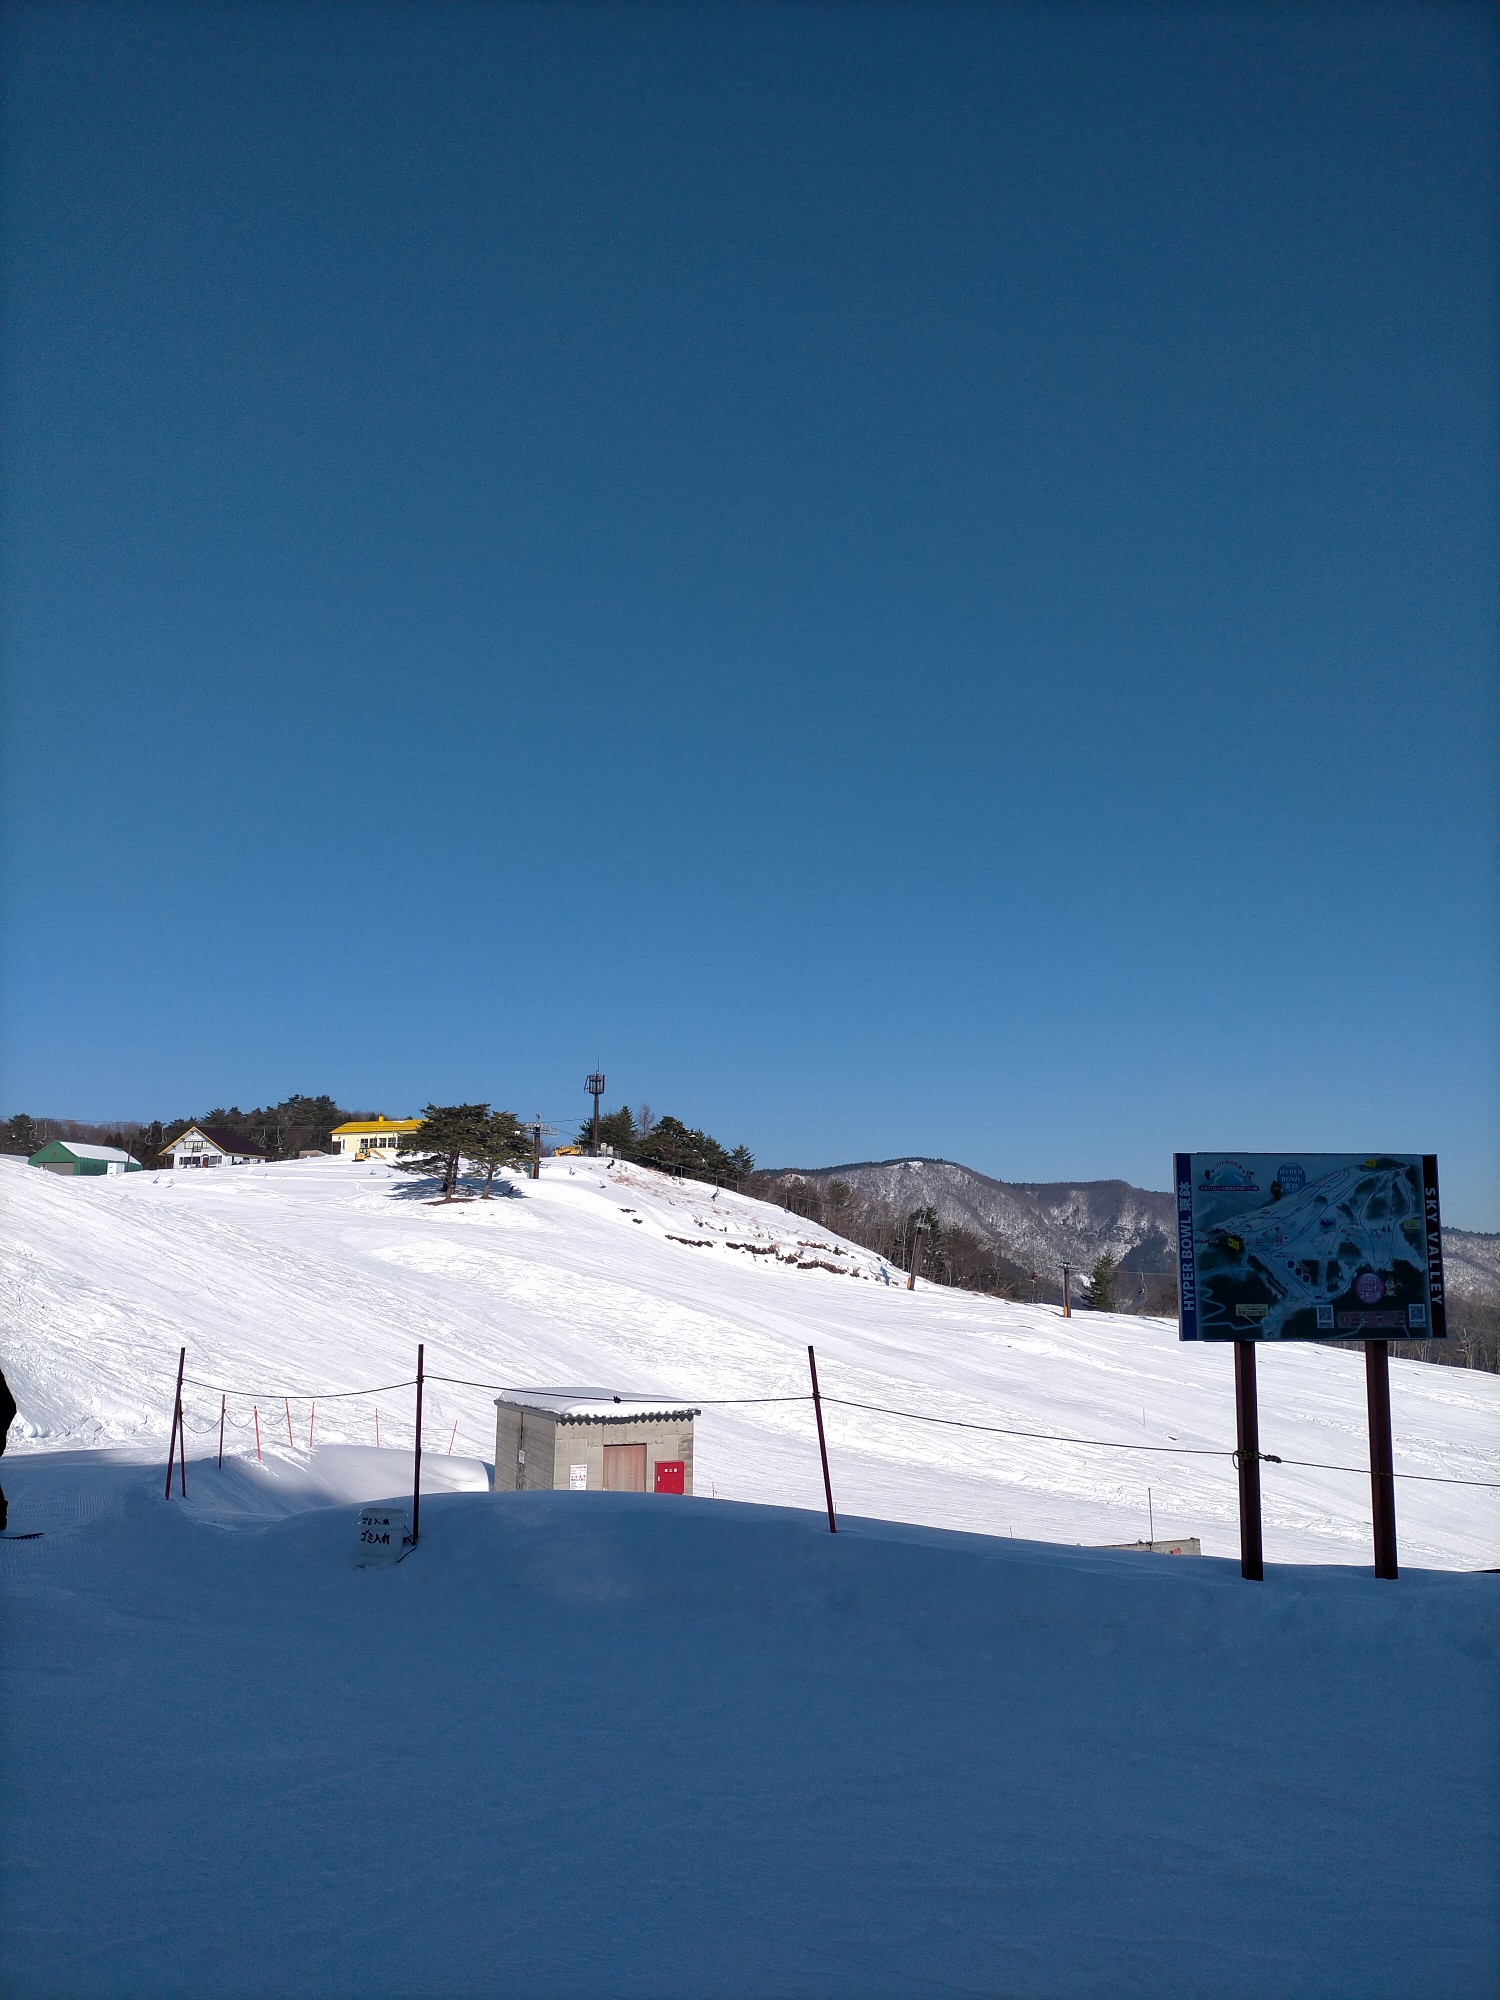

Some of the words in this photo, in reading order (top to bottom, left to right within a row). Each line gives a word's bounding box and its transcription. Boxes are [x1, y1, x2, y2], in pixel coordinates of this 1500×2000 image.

[1279, 1168, 1303, 1176] HYPER
[1281, 1175, 1301, 1183] BOWL
[1178, 1181, 1192, 1211] 東鉢
[1425, 1187, 1438, 1223] SKY
[1180, 1216, 1193, 1259] BOWL
[1427, 1232, 1442, 1305] VALLEY
[1182, 1262, 1195, 1311] HYPER
[360, 1529, 390, 1545] ゴミ入れ
